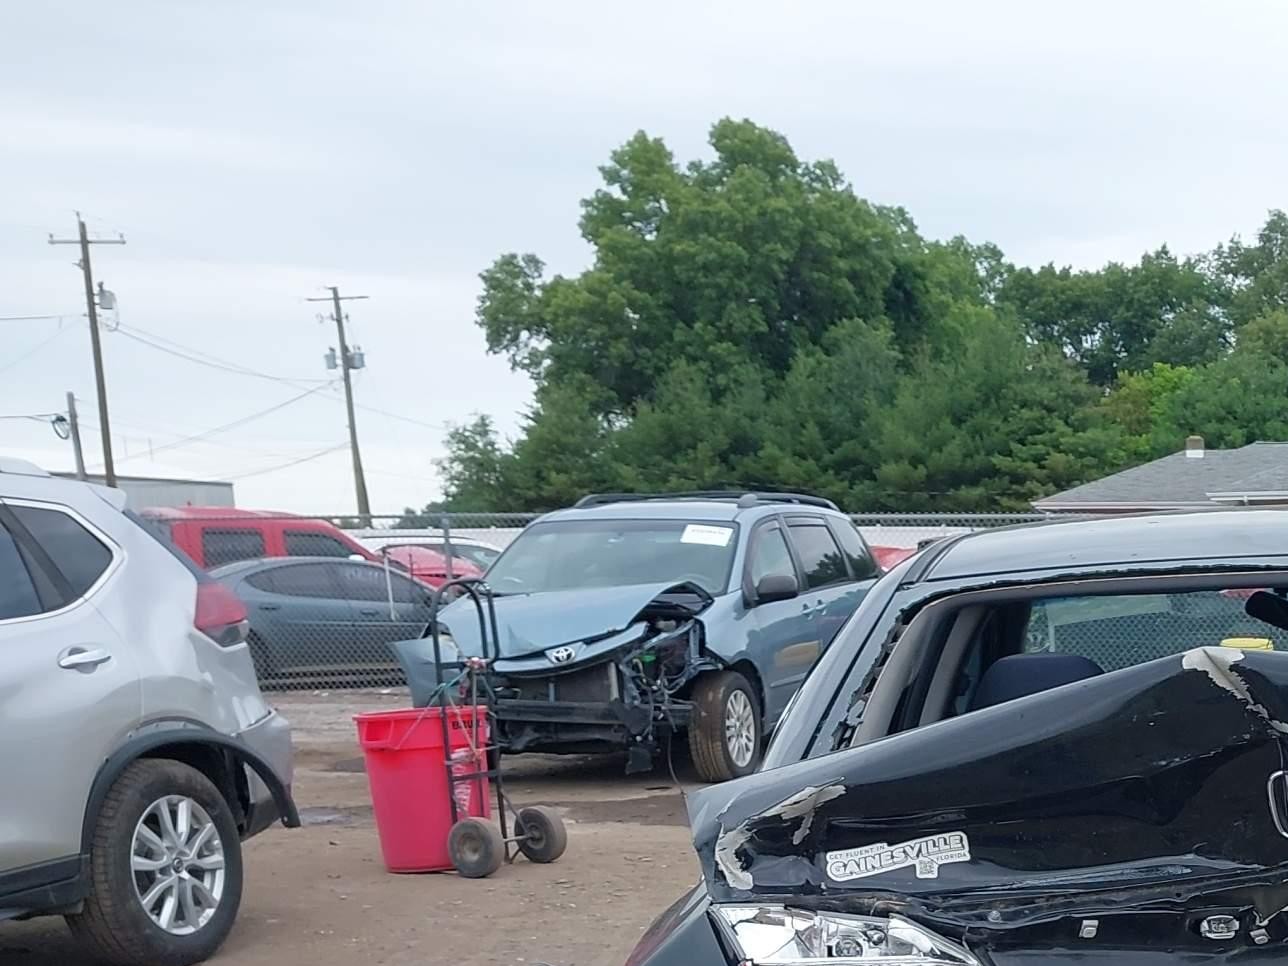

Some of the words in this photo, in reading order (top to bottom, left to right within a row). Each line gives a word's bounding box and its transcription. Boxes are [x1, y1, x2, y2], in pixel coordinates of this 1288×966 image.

[830, 834, 964, 877] GAINESVILLE
[846, 848, 875, 857] FLUENT
[936, 852, 967, 862] FLORIDA
